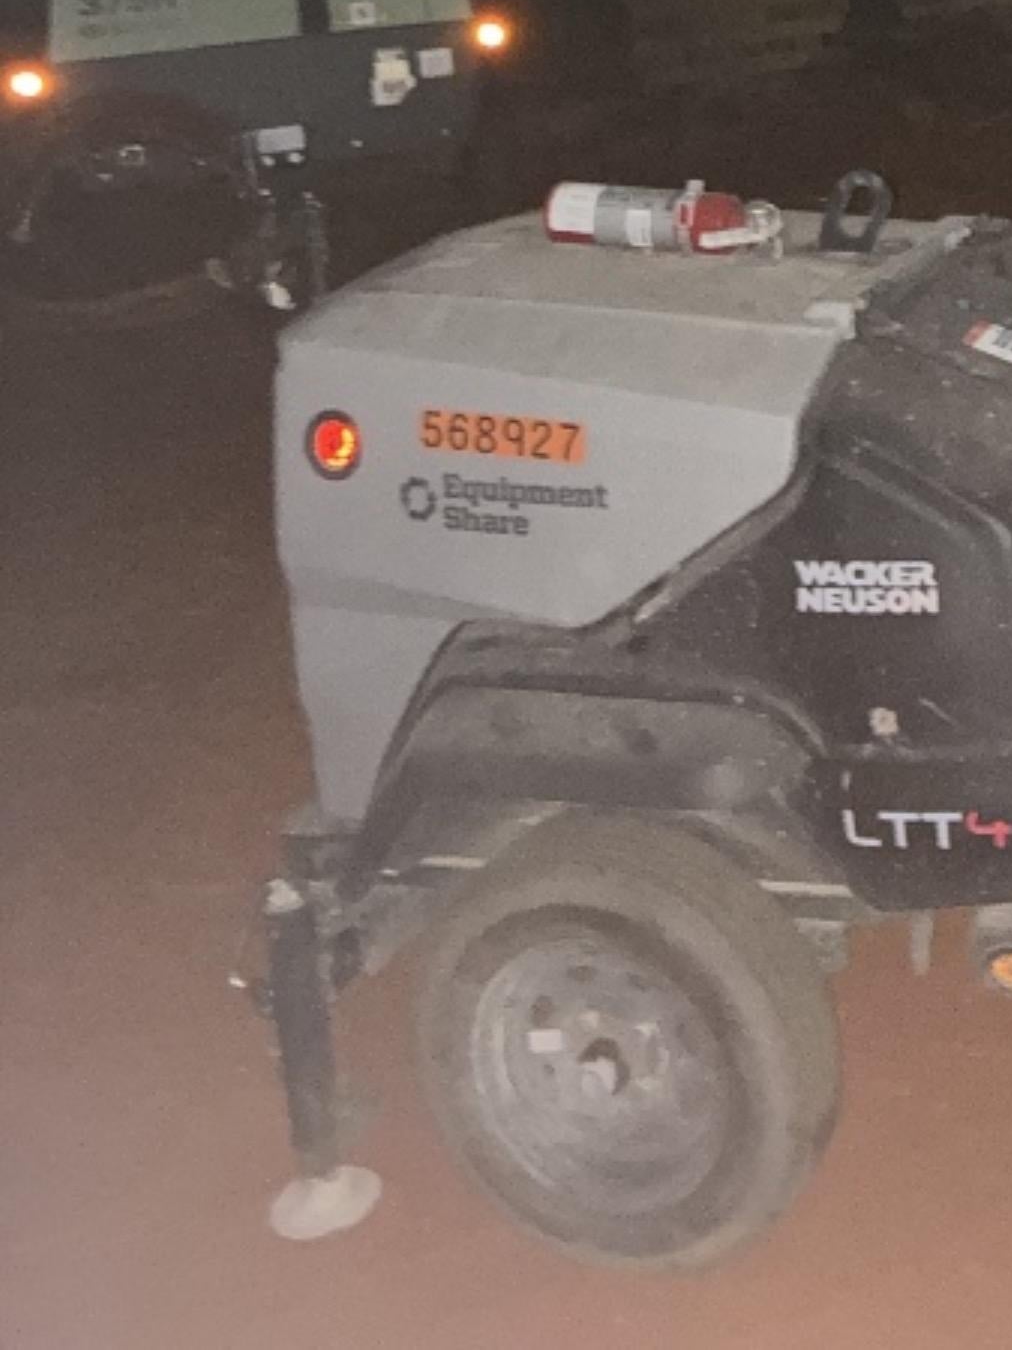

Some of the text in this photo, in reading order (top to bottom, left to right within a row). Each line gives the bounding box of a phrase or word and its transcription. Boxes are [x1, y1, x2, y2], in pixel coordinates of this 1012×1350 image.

[420, 410, 582, 460] 568927
[442, 473, 609, 509] Equipment
[442, 506, 530, 536] Share
[794, 560, 939, 587] WACKER
[795, 587, 940, 614] NEUSON
